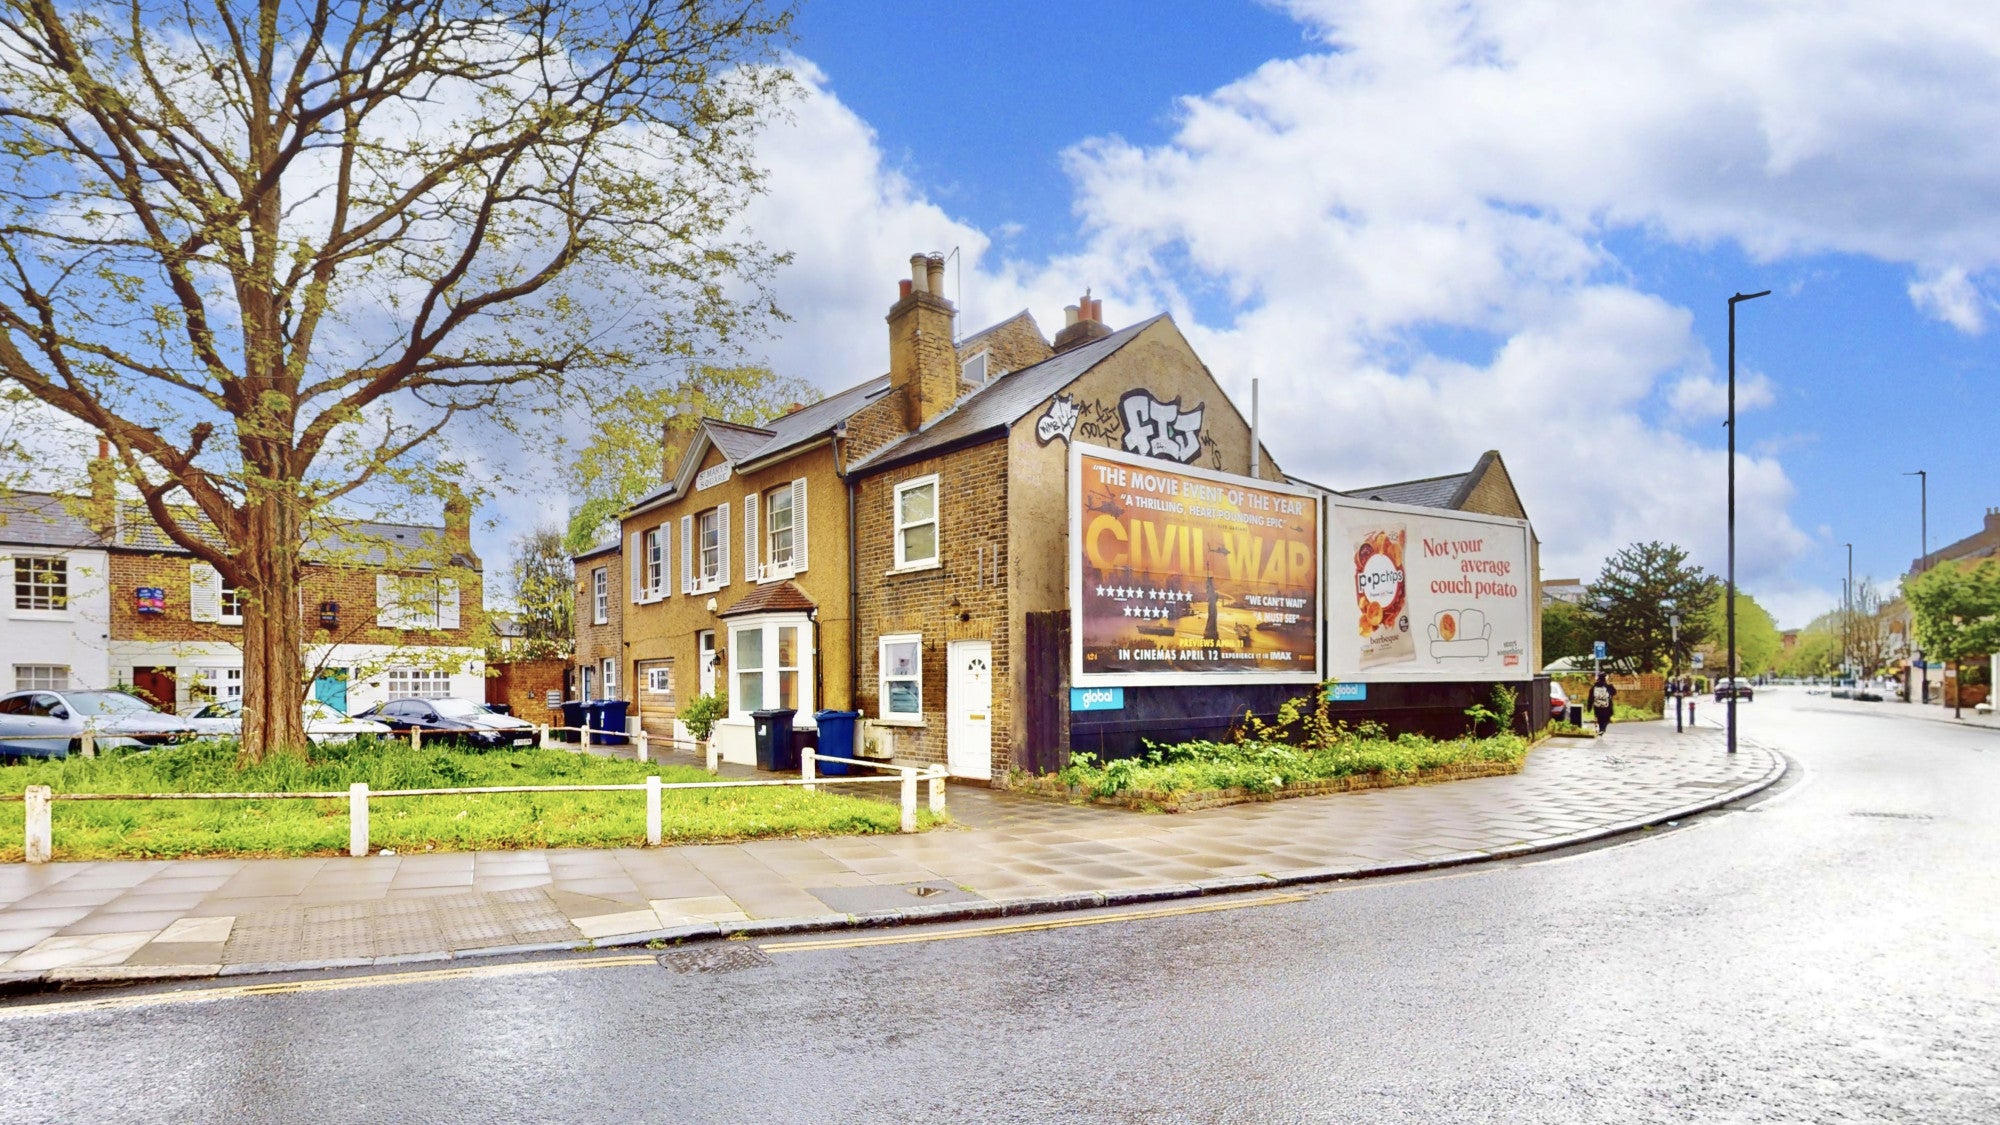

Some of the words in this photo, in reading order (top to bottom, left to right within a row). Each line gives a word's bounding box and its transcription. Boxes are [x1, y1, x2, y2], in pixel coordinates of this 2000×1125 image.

[1131, 472, 1178, 496] MOVIE
[1183, 482, 1224, 503] EVENT
[1228, 490, 1244, 506] OF
[1248, 493, 1269, 511] THE
[1189, 506, 1265, 525] HEART-POUNDING
[1086, 515, 1212, 577] CIVIL
[1223, 532, 1312, 588] WAR
[1423, 537, 1449, 558] Not
[1452, 538, 1483, 560] your
[1460, 559, 1511, 577] average
[1430, 574, 1472, 594] couch
[1475, 580, 1518, 600] potato
[1262, 596, 1284, 607] CAN'T
[1263, 612, 1284, 623] MUST
[1179, 638, 1214, 648] PREVIEWS
[1118, 648, 1130, 660] IN
[1134, 649, 1176, 660] CINEMAS
[1180, 649, 1205, 660] APRIL
[1208, 649, 1219, 660] 12
[1221, 652, 1254, 660] EXPERIENCE
[1270, 651, 1292, 660] IMAX
[1083, 688, 1113, 708] global
[1335, 684, 1358, 699] global
